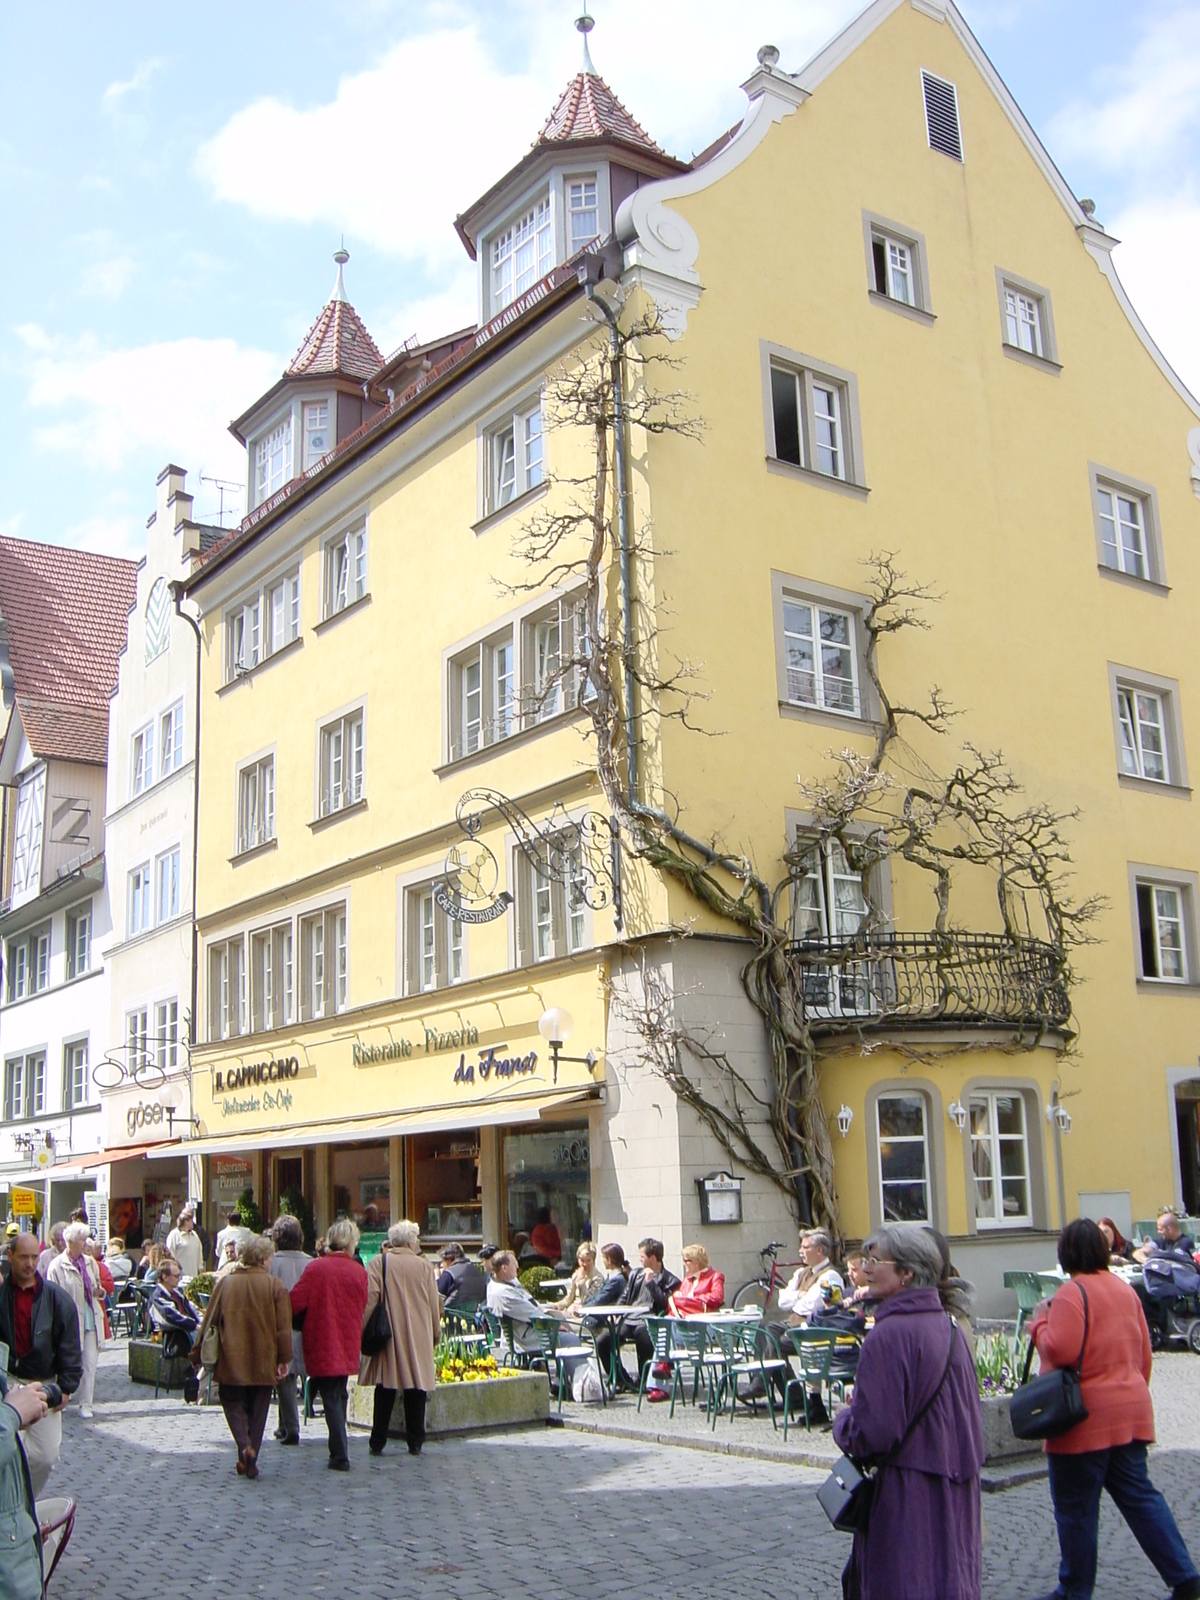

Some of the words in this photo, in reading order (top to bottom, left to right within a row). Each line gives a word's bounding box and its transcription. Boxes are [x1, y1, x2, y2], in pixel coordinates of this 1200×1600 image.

[352, 1038, 412, 1067] Ristorante
[425, 1020, 479, 1053] Pizzeria
[227, 1056, 299, 1088] CAPPUCCINO
[454, 1054, 475, 1082] da
[478, 1044, 538, 1078] Franco
